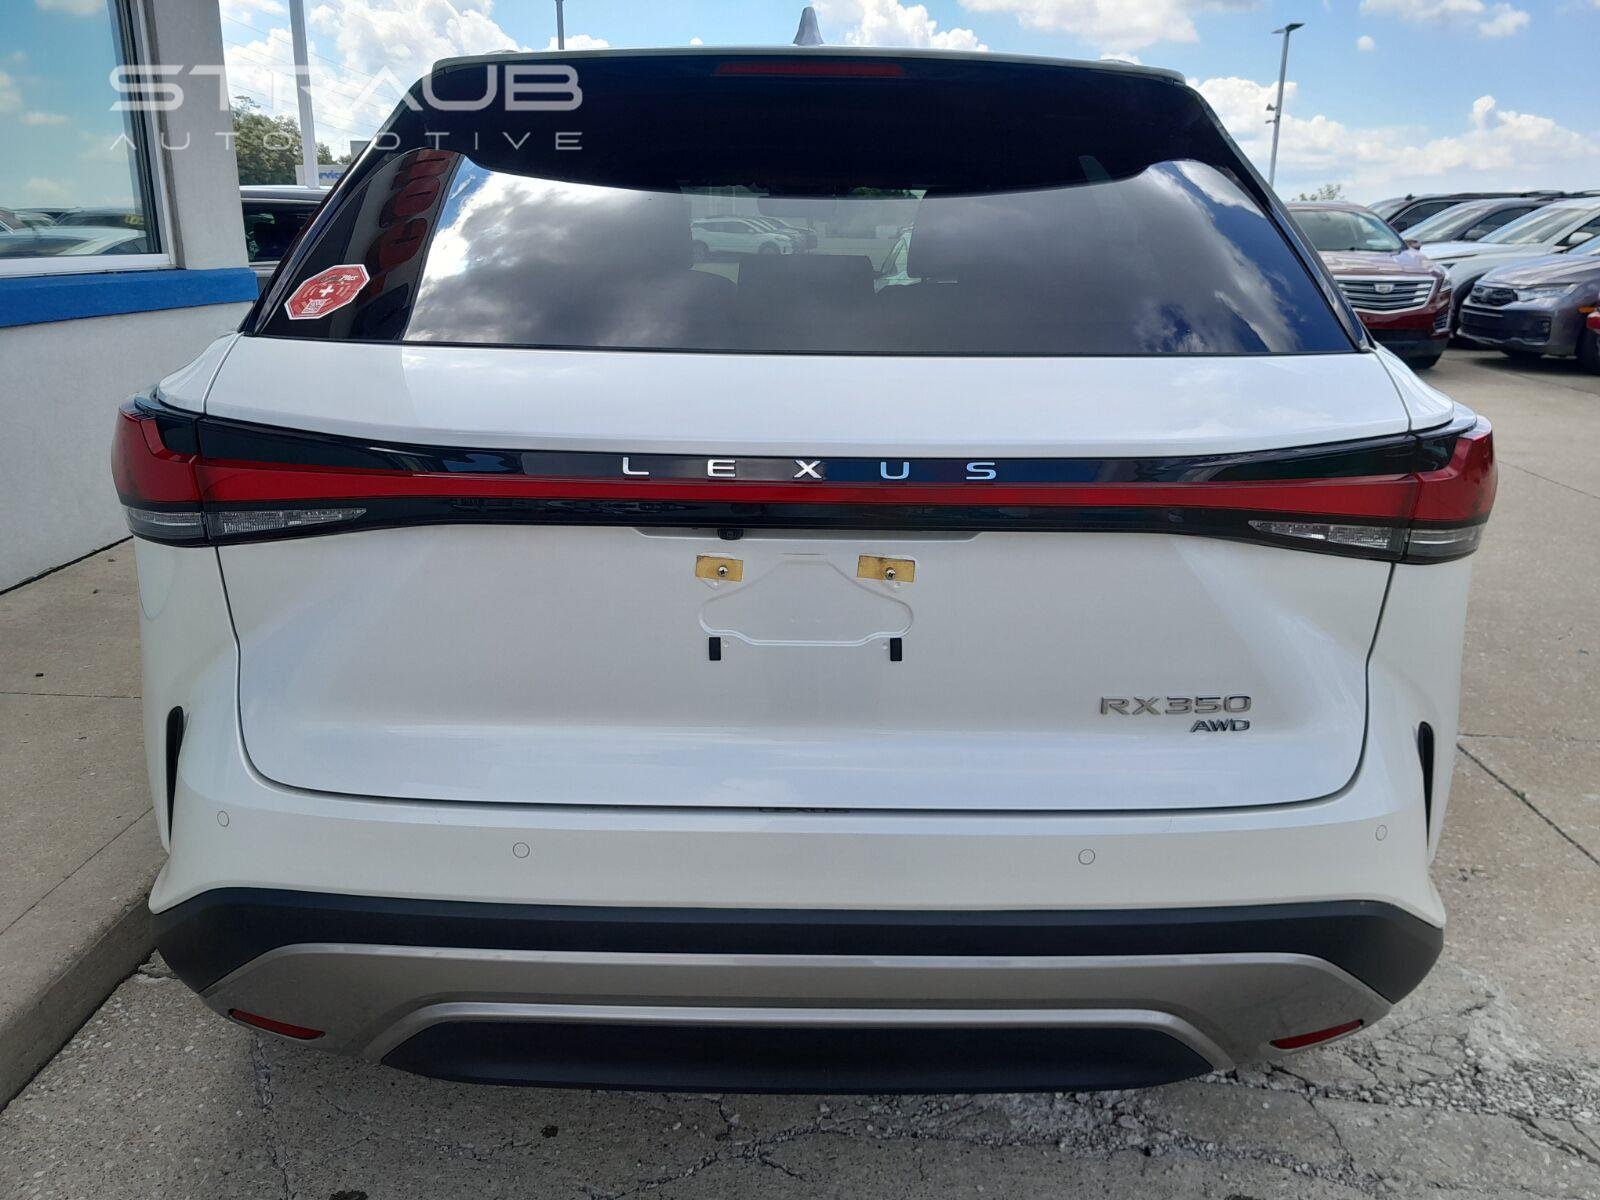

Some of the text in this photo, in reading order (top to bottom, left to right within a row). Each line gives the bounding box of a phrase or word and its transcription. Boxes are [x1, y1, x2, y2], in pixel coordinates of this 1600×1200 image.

[622, 457, 997, 480] LEXUS
[1100, 695, 1252, 715] RX350
[1190, 719, 1250, 733] AWD
